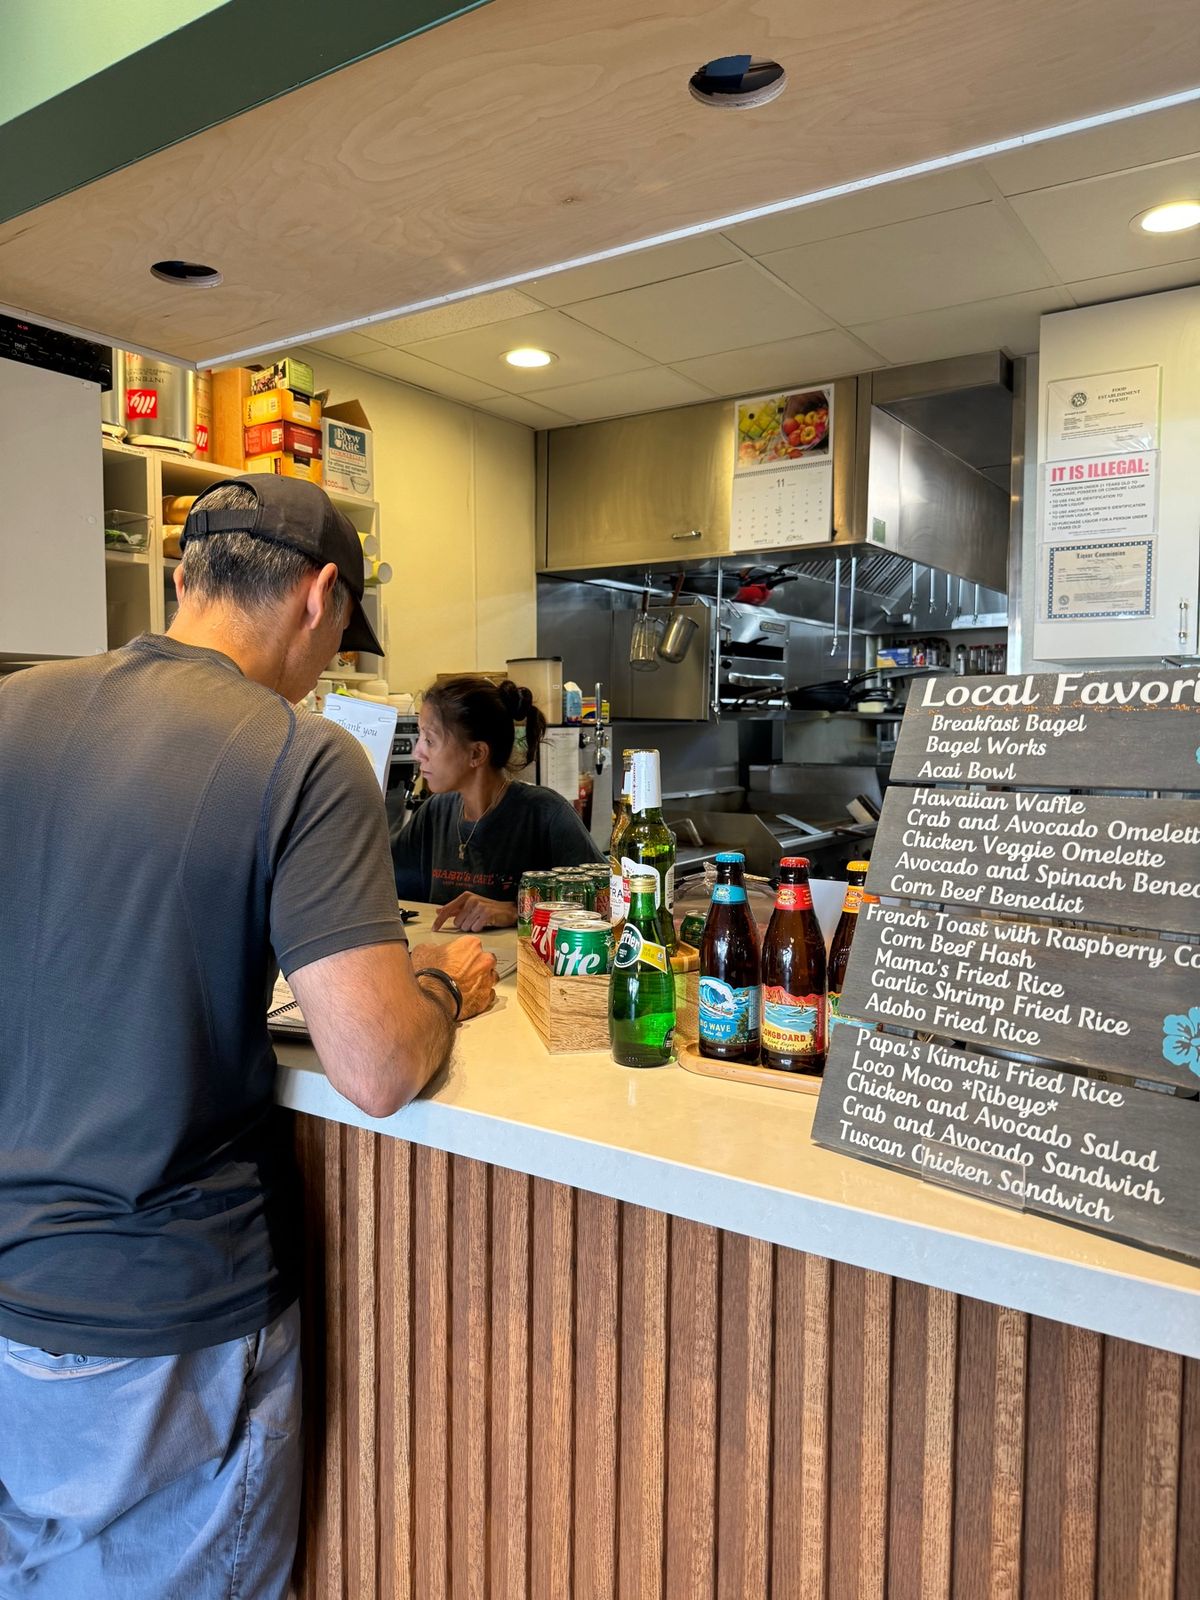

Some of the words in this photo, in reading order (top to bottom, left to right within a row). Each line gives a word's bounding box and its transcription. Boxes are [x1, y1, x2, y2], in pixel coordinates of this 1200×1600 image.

[129, 391, 156, 414] illy
[336, 427, 361, 443] Brew
[1052, 467, 1066, 482] IT
[1069, 465, 1084, 480] IS
[1088, 458, 1149, 478] ILLEGAL:
[921, 676, 1040, 707] Local
[361, 727, 378, 738] you
[931, 714, 1020, 732] Breakfast
[1026, 714, 1087, 737] Bagel
[926, 735, 981, 758] Bagel
[987, 737, 1047, 756] Works
[918, 760, 962, 779] Acai
[967, 761, 1016, 780] Bowl
[912, 788, 1008, 811] Hawaiian
[1015, 793, 1086, 815] Waffle
[907, 808, 951, 828] Crab
[958, 813, 1000, 832] and
[1004, 814, 1098, 838] Avocado
[902, 829, 977, 853] Chicken
[983, 835, 1056, 863] Veggie
[1062, 841, 1166, 868] Omelette
[895, 851, 979, 876] Avocado
[986, 863, 1030, 881] and
[1035, 864, 1126, 891] Spinach
[890, 874, 935, 896] Corn
[940, 880, 986, 902] Beef
[989, 885, 1085, 914] Benedict
[866, 903, 929, 929] French
[935, 912, 989, 938] Toast
[994, 924, 1041, 946] with
[1046, 928, 1166, 968] Raspberry
[880, 927, 925, 950] Corn
[930, 934, 976, 958] Beef
[979, 942, 1036, 969] Hash
[874, 947, 949, 978] Mama's
[955, 961, 1011, 989] Fried
[1017, 972, 1065, 998] Rice
[865, 992, 927, 1021] Adobo
[933, 1005, 988, 1035] Fried
[992, 1018, 1041, 1045] Rice
[871, 969, 929, 996] Garlic
[932, 980, 1005, 1016] Shrimp
[1013, 994, 1072, 1025] Fried
[1078, 1006, 1131, 1036] Rice
[709, 1022, 731, 1033] WAVE
[852, 1051, 895, 1078] Loco
[901, 1063, 953, 1093] Moco
[856, 1028, 921, 1060] Papa's
[926, 1044, 1000, 1079] Kimchi
[1005, 1061, 1066, 1094] Fried
[1071, 1076, 1125, 1107] Rice
[847, 1072, 921, 1108] Chicken
[926, 1098, 969, 1121] and
[974, 1105, 1072, 1149] Avocado
[1080, 1132, 1160, 1173] Salad
[842, 1095, 887, 1124] Crab
[893, 1115, 936, 1138] and
[939, 1123, 1034, 1167] Avocado
[1041, 1152, 1165, 1205] Sandwich
[839, 1120, 906, 1158] Tuscan
[911, 1143, 993, 1186] Chicken
[997, 1170, 1115, 1223] Sandwich
